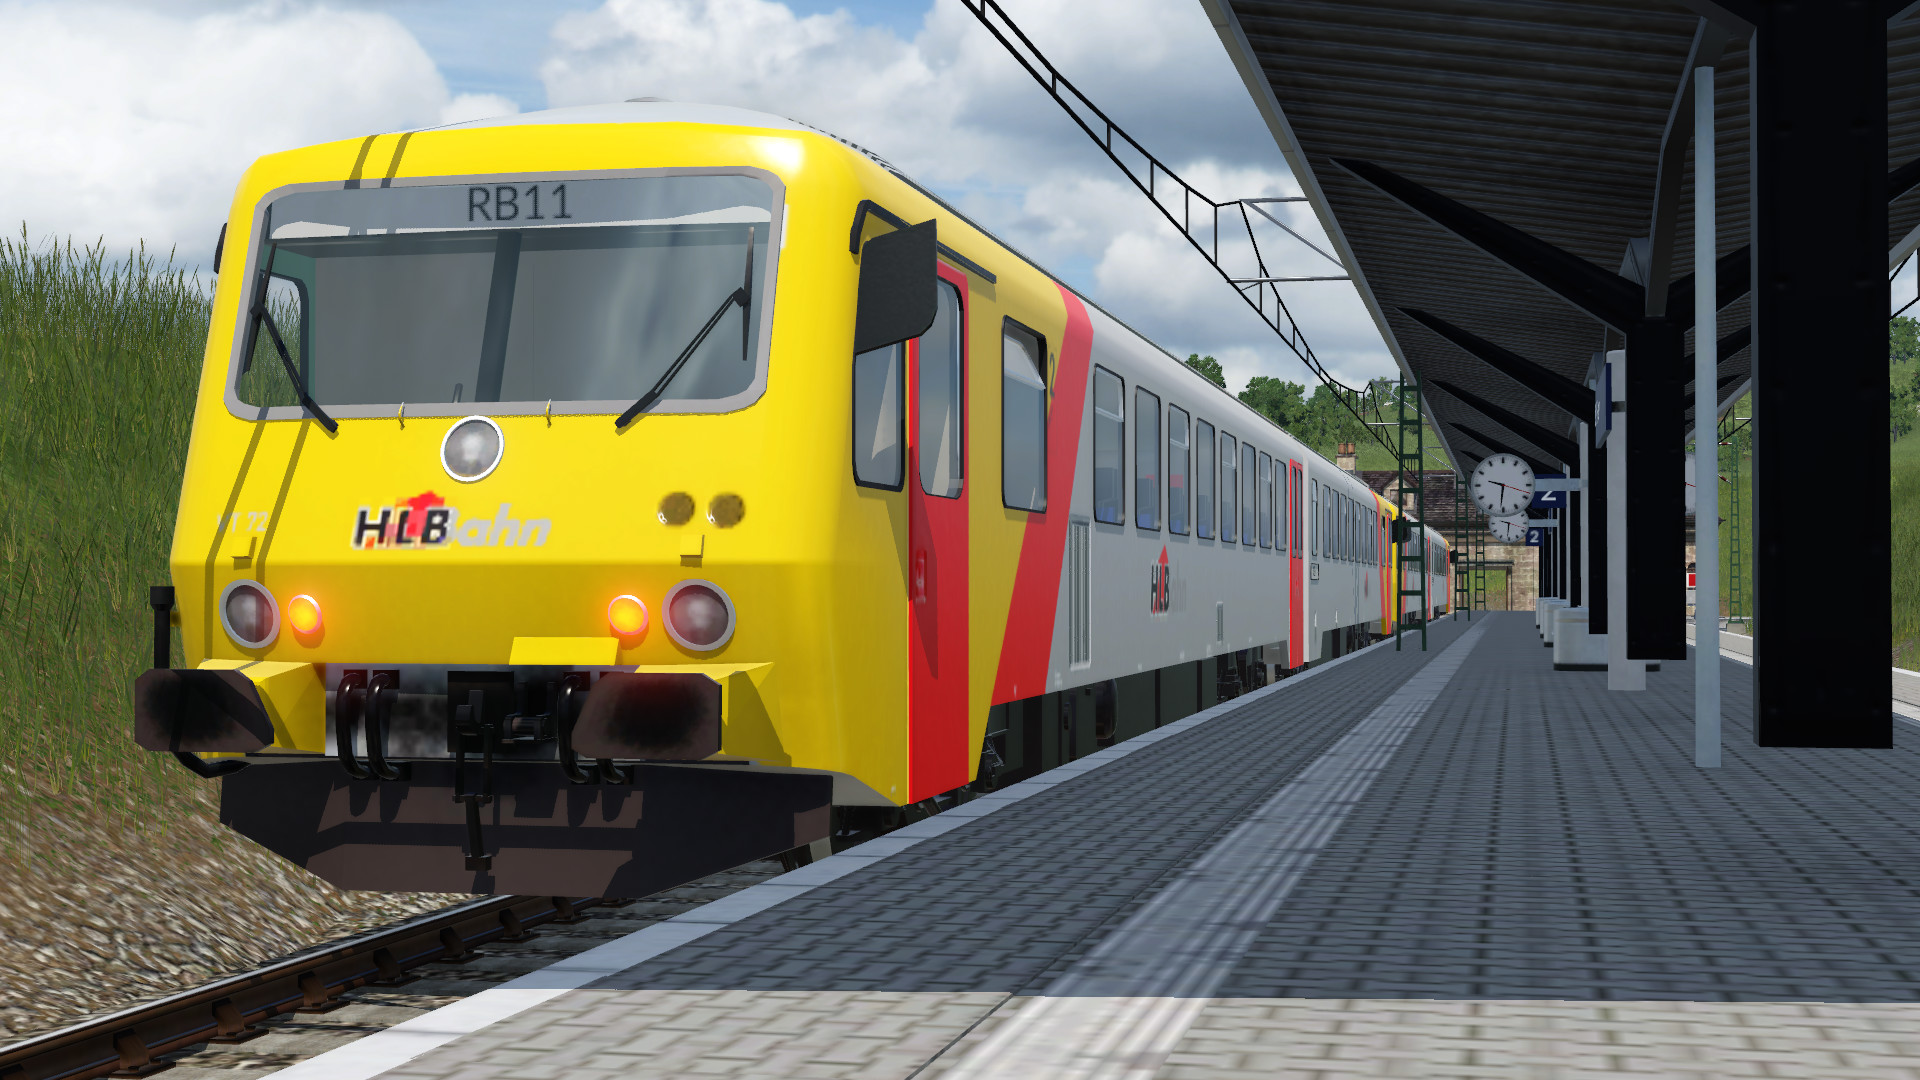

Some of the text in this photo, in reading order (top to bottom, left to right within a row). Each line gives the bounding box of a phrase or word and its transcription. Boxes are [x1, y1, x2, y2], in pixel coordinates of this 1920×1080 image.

[468, 184, 572, 221] RB11
[354, 505, 451, 550] HLB
[1529, 529, 1540, 543] 2
